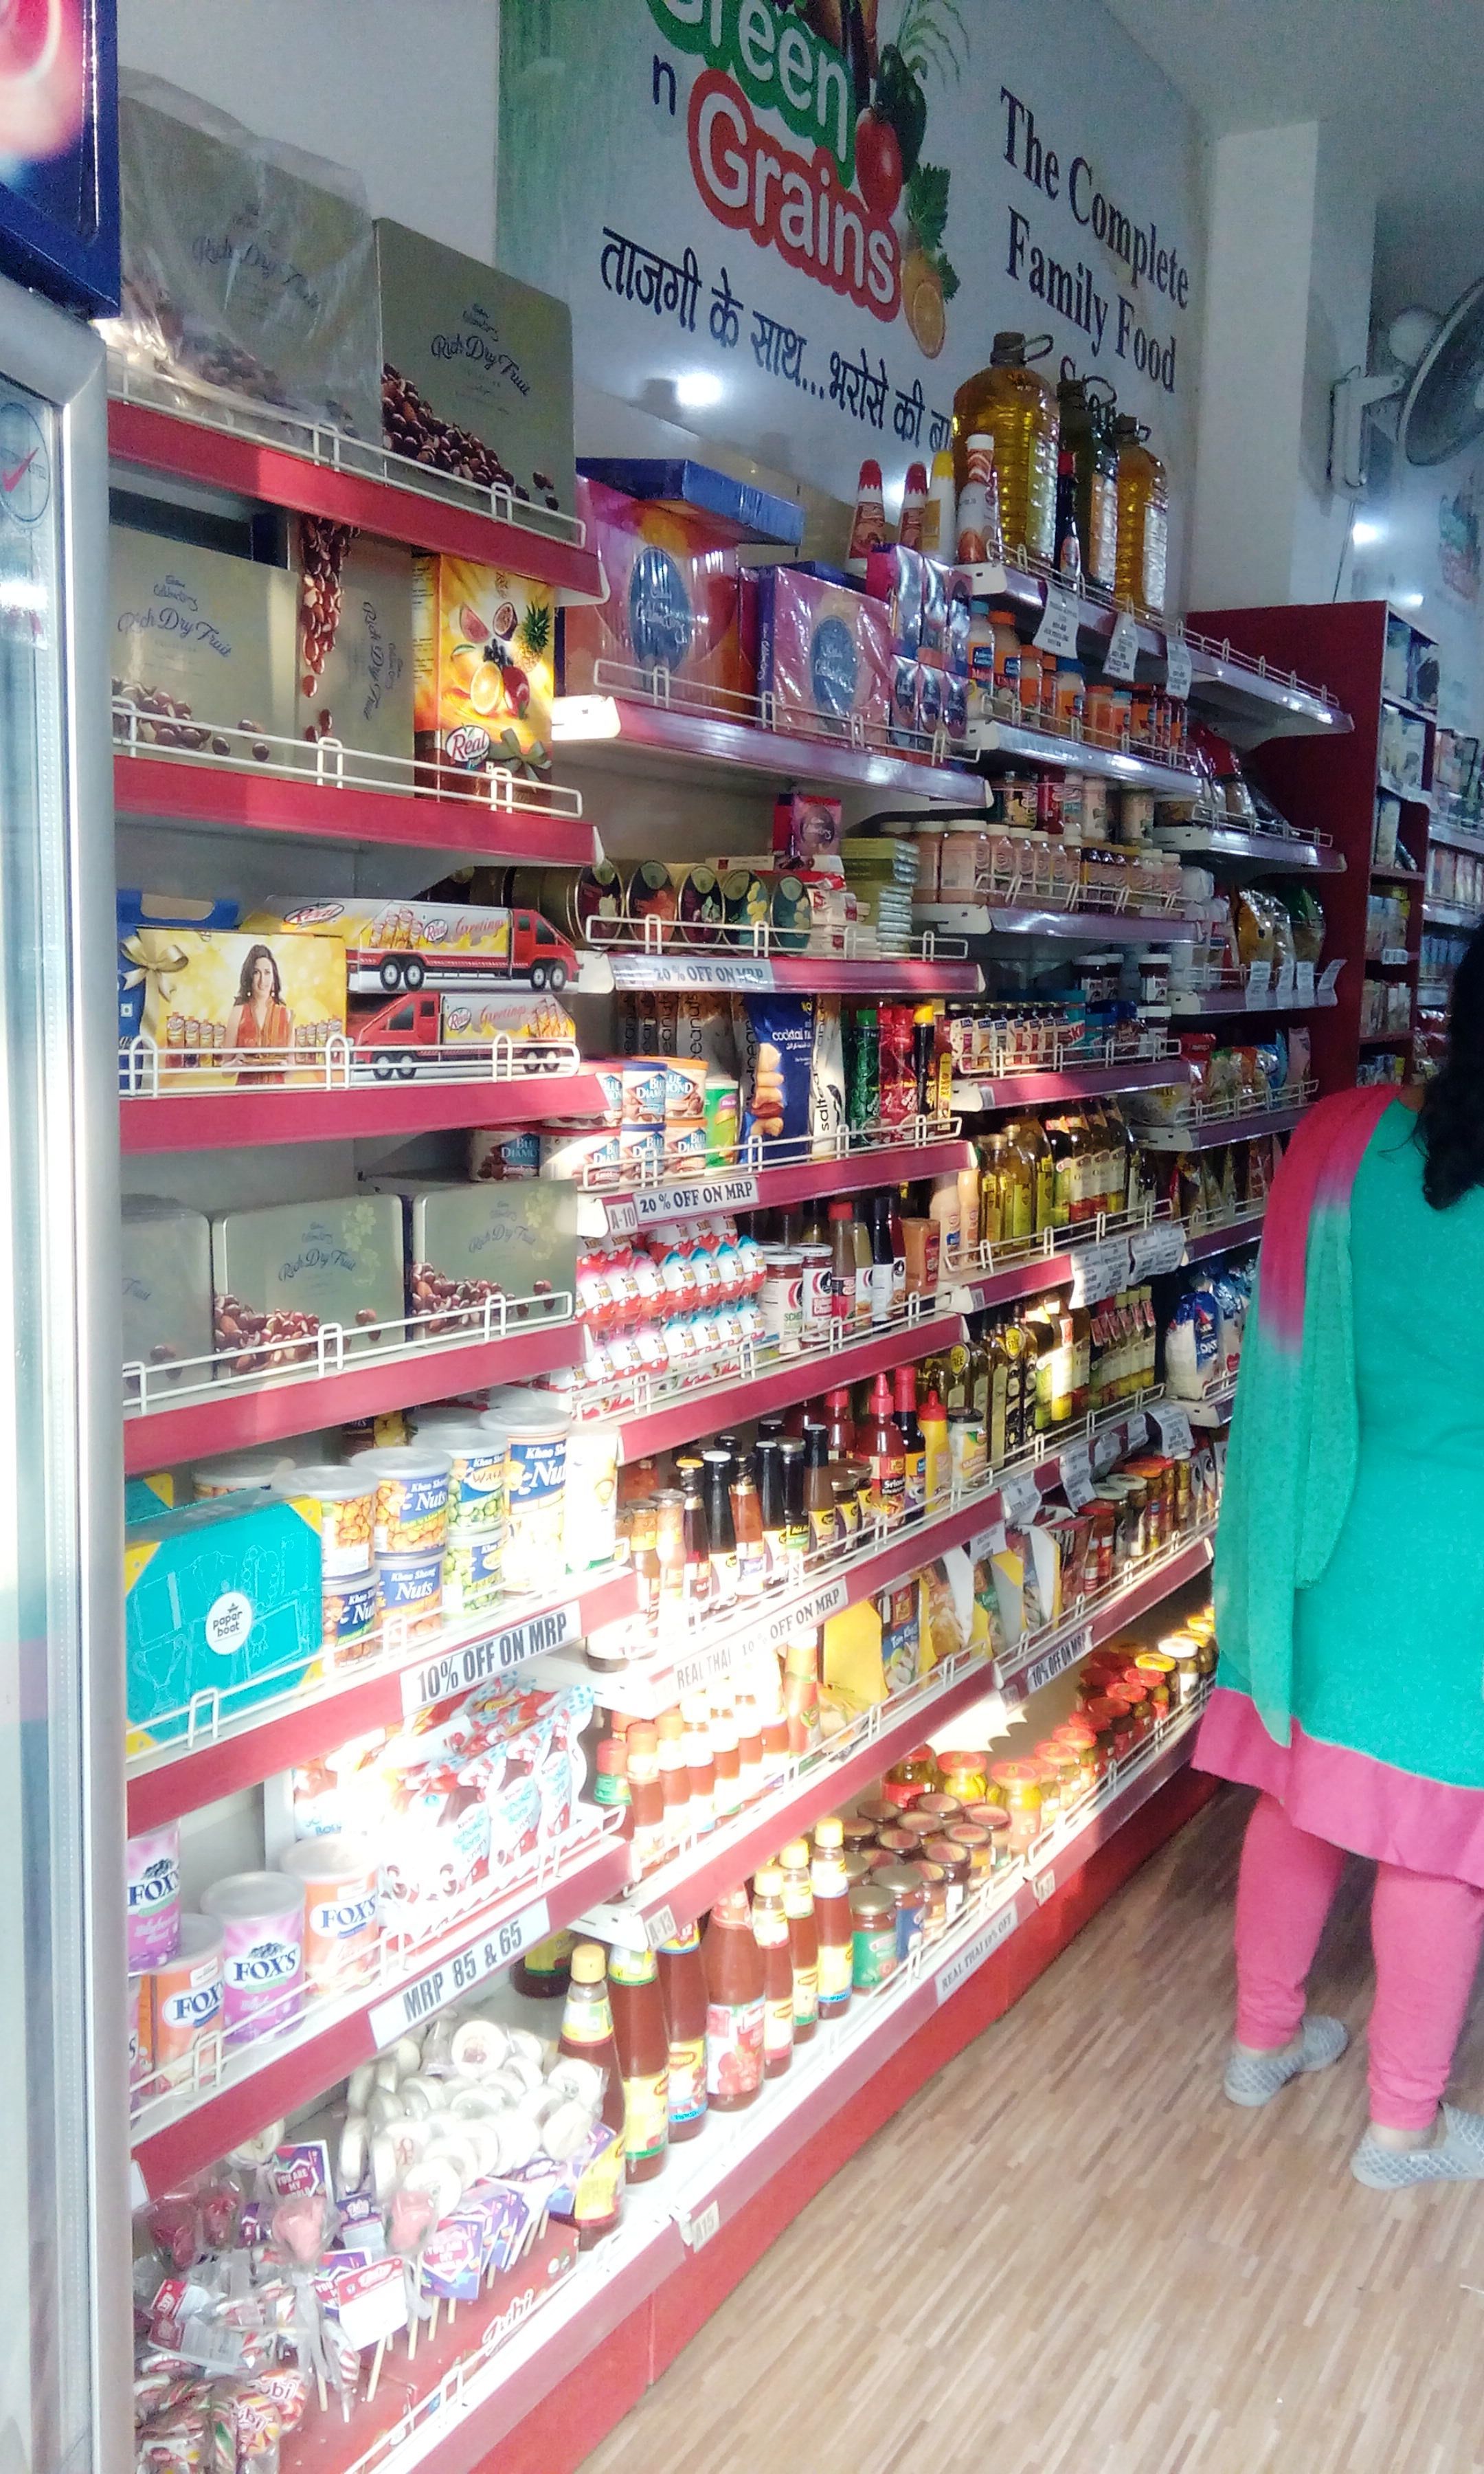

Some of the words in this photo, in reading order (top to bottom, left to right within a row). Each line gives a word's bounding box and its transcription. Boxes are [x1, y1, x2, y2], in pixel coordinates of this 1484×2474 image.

[653, 54, 677, 115] n
[697, 93, 895, 304] Grains
[1000, 85, 1059, 201] The
[1068, 156, 1189, 311] Complete
[1006, 205, 1108, 357] Family
[1114, 293, 1177, 394] Food
[465, 335, 496, 370] Dry
[600, 226, 702, 333] ताजगी
[710, 267, 744, 348] के
[829, 348, 888, 430] भरोसे
[894, 379, 925, 448] की
[929, 410, 953, 454] बा
[157, 608, 194, 638] Dry
[195, 621, 232, 658] Fruit
[451, 732, 488, 759] Real
[687, 966, 712, 982] OFF
[716, 966, 736, 983] ON
[684, 993, 702, 1060] eanuts
[610, 1207, 636, 1229] A-10
[640, 1198, 657, 1214] 20
[658, 1192, 671, 1210] %
[673, 1189, 699, 1207] OFF
[703, 1185, 721, 1203] ON
[724, 1181, 752, 1200] MRP
[306, 1248, 328, 1269] Dry
[415, 1491, 447, 1511] Nuts
[395, 1581, 433, 1601] Nuts
[216, 1620, 242, 1638] boat
[677, 1662, 704, 1691] REAL
[708, 1647, 732, 1675] THAI
[770, 1614, 793, 1640] OFF
[796, 1603, 814, 1625] ON
[816, 1587, 840, 1613] MRP
[417, 1655, 459, 1703] 10%
[462, 1641, 495, 1683] OFF
[499, 1627, 525, 1666] ON
[528, 1612, 567, 1656] MRP
[1048, 1649, 1061, 1676] OFF
[403, 1970, 444, 2023] MRP
[452, 1950, 477, 1989] 85
[483, 1943, 498, 1968] &
[499, 1919, 522, 1957] 65
[942, 1963, 963, 1992] REAL
[965, 1941, 984, 1969] THAI
[998, 1912, 1013, 1934] OFF
[278, 2172, 293, 2187] YOU
[293, 2167, 309, 2181] ARE
[289, 2180, 301, 2191] MY
